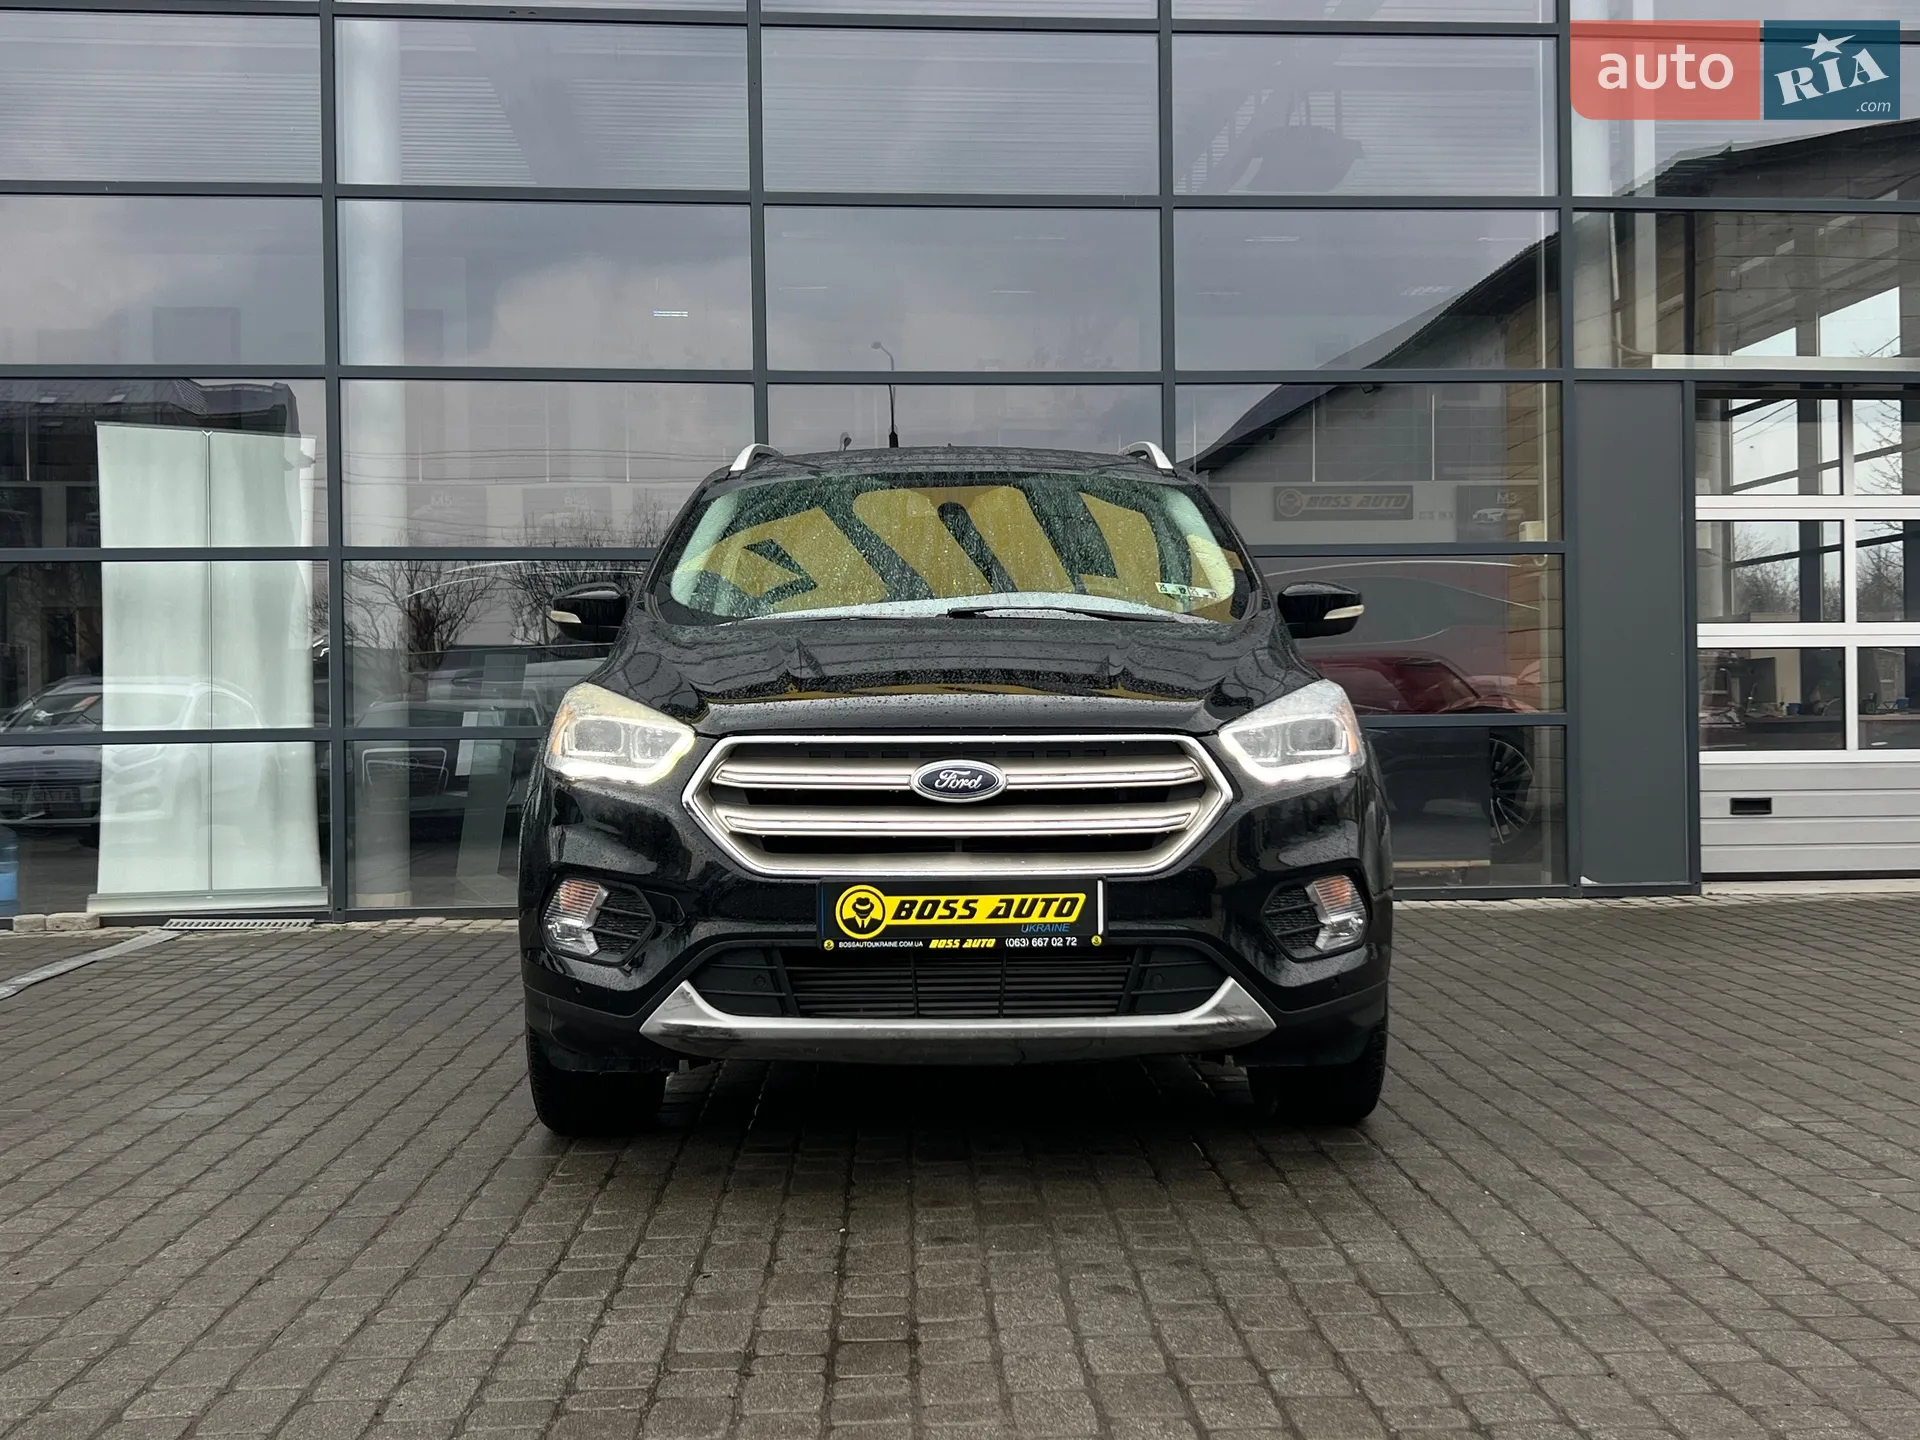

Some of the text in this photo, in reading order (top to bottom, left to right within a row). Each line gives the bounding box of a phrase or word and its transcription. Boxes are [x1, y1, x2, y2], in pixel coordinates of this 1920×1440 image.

[1305, 494, 1408, 508] BOSS AUTO
[934, 769, 983, 789] Ford
[891, 896, 1081, 921] BOSS AUTO
[1020, 923, 1071, 933] UKRAINE
[929, 939, 961, 949] BOSS
[962, 938, 996, 948] AUTO
[1005, 937, 1030, 948] (063)
[1031, 937, 1049, 947] 667
[1051, 937, 1064, 947] 02
[1065, 936, 1078, 947] 72
